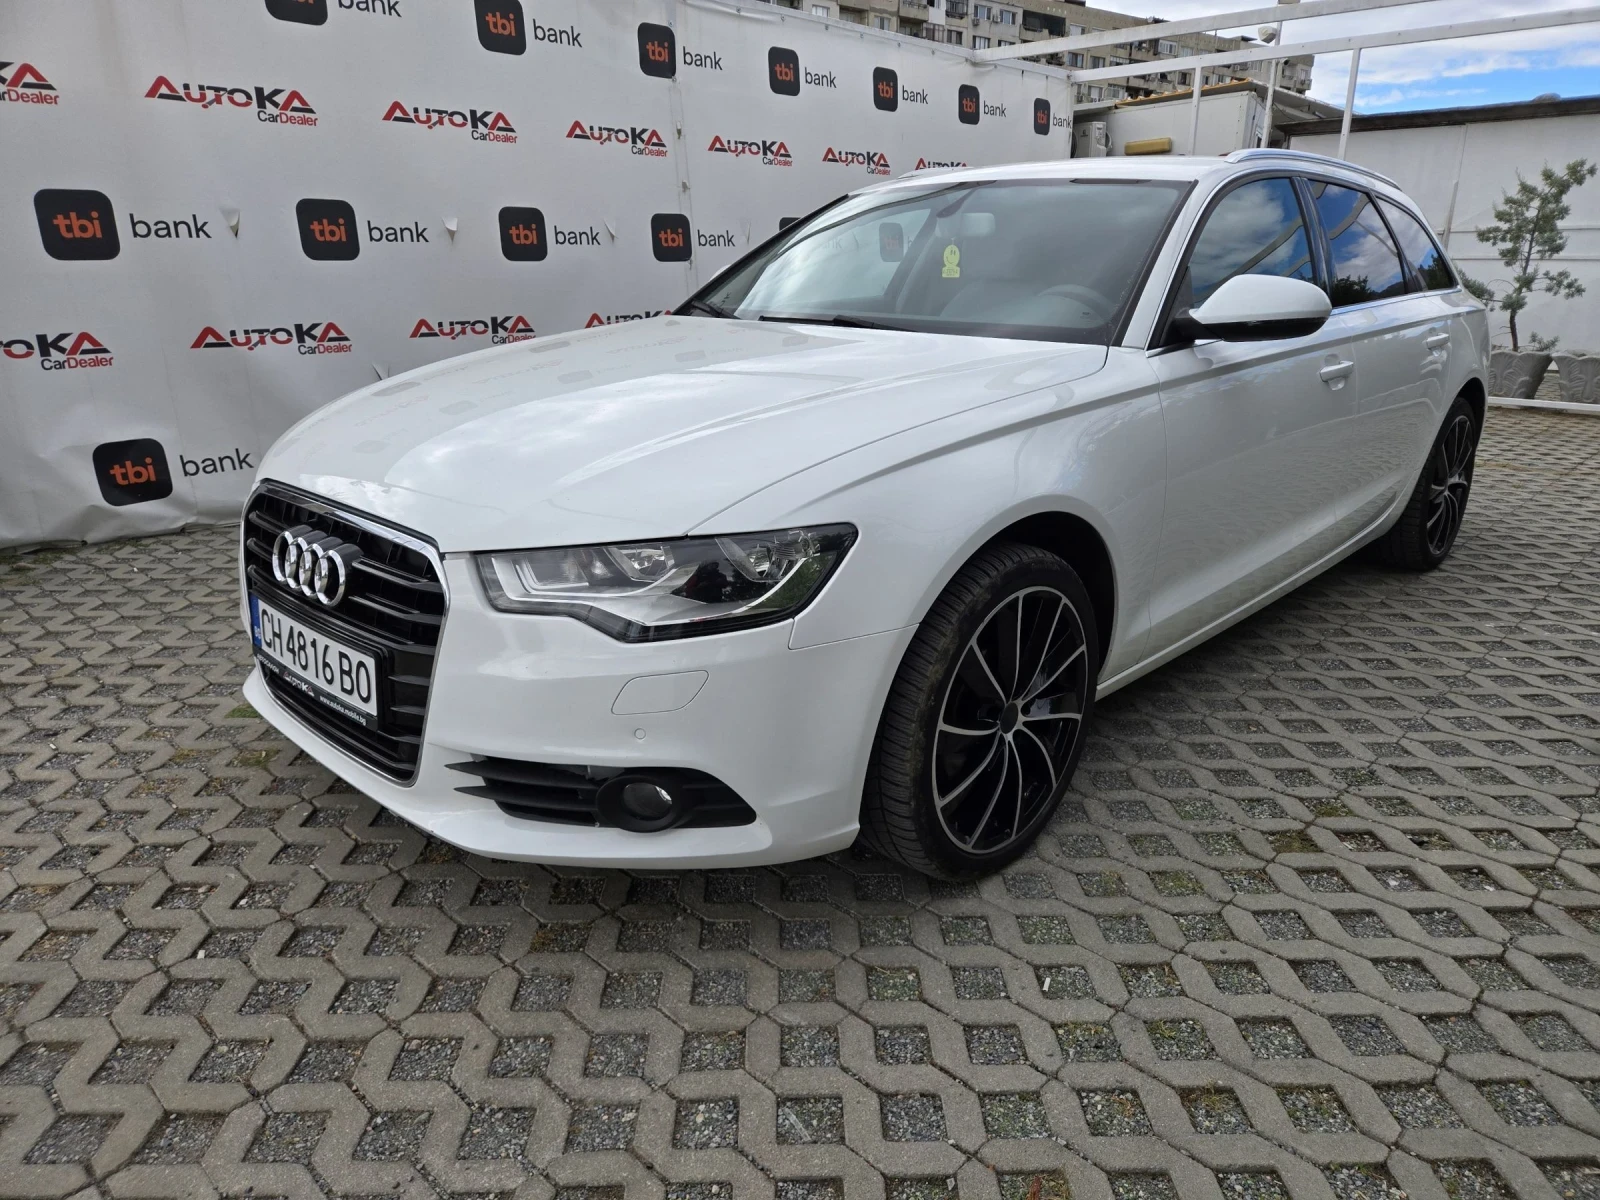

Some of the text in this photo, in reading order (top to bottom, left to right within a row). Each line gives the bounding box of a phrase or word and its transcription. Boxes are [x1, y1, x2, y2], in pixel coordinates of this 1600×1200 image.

[486, 12, 583, 48] tbi bank
[646, 41, 723, 71] tbi bank
[774, 61, 837, 89] tbi bank
[0, 89, 60, 105] rDealer
[878, 80, 929, 105] tbi bank
[962, 96, 1007, 118] tbi bank
[257, 110, 319, 127] CarDealer
[1052, 112, 1072, 129] bank
[471, 130, 518, 144] CarDealer
[631, 145, 668, 157] CarDealer
[53, 211, 212, 240] tbi bank
[310, 218, 429, 244] tbi bank
[509, 224, 601, 247] tbi bank
[659, 228, 735, 248] tbi bank
[0, 331, 112, 359] OKA
[298, 342, 353, 355] CarDealer
[41, 356, 114, 371] CarDealer
[109, 448, 254, 486] tbi bank
